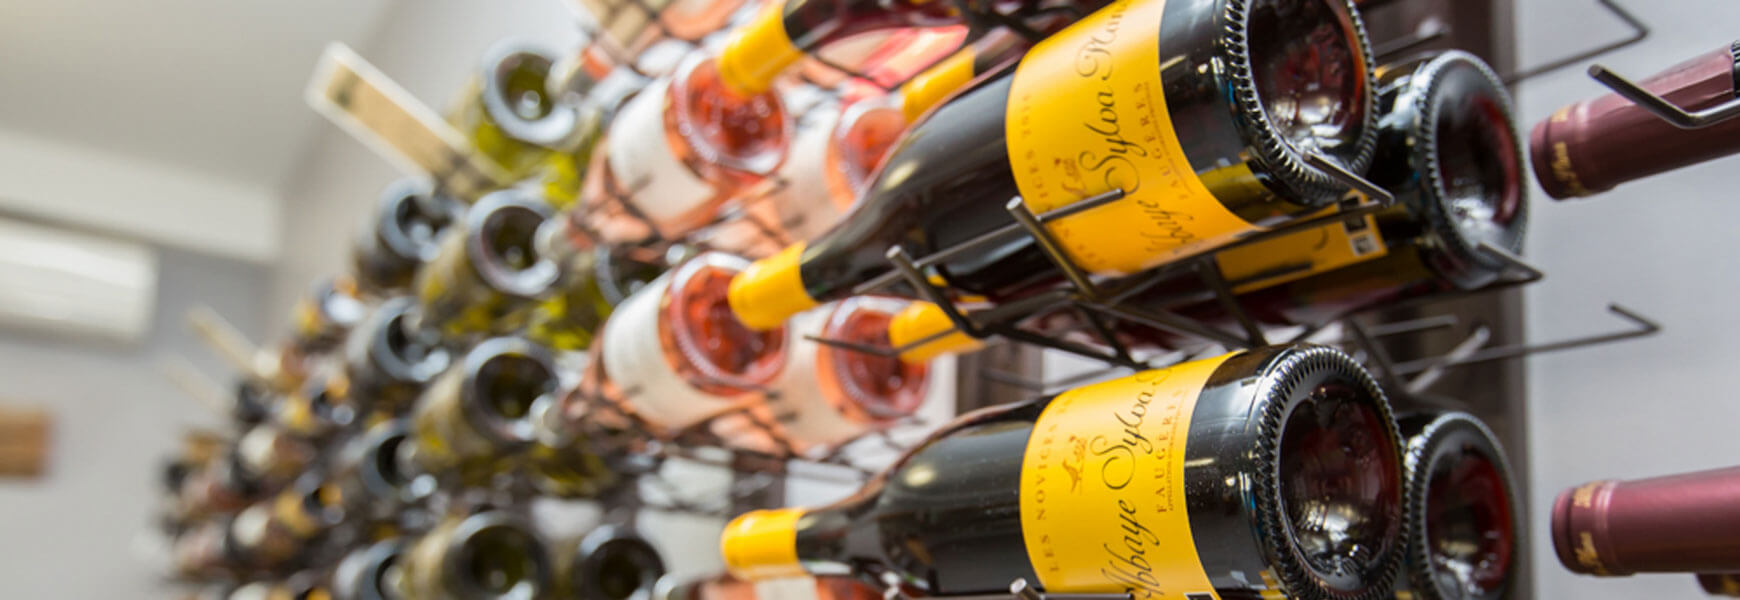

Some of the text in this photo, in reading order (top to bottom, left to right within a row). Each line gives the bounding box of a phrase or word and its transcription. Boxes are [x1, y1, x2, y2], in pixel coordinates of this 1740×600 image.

[1078, 87, 1147, 195] Sylva
[1089, 391, 1153, 490] Sylva
[1035, 423, 1060, 573] LES NOVICES
